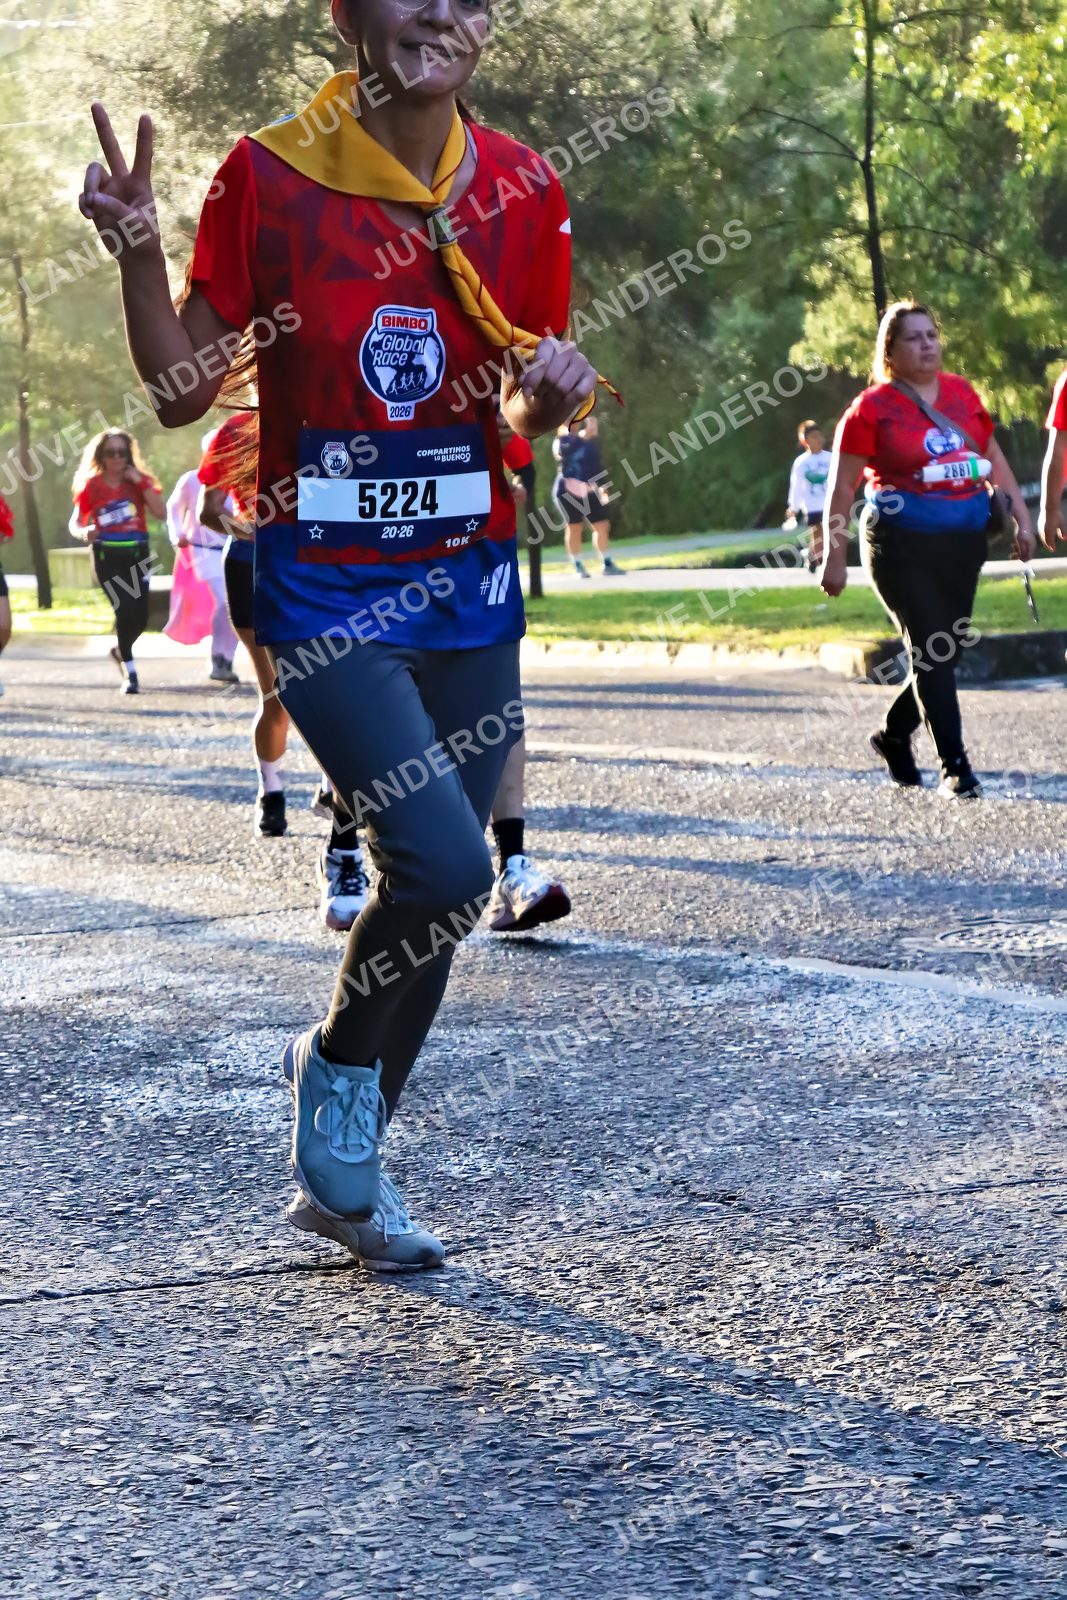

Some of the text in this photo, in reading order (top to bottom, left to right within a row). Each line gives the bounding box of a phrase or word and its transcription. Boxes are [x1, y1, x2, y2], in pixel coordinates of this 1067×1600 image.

[382, 316, 429, 330] BIMBO
[382, 335, 426, 354] Global
[373, 349, 409, 366] Race
[390, 406, 412, 418] 2026
[416, 445, 471, 457] COMPARTIMOS
[944, 463, 971, 479] 2881
[358, 479, 438, 519] 5224
[445, 535, 470, 549] 10K
